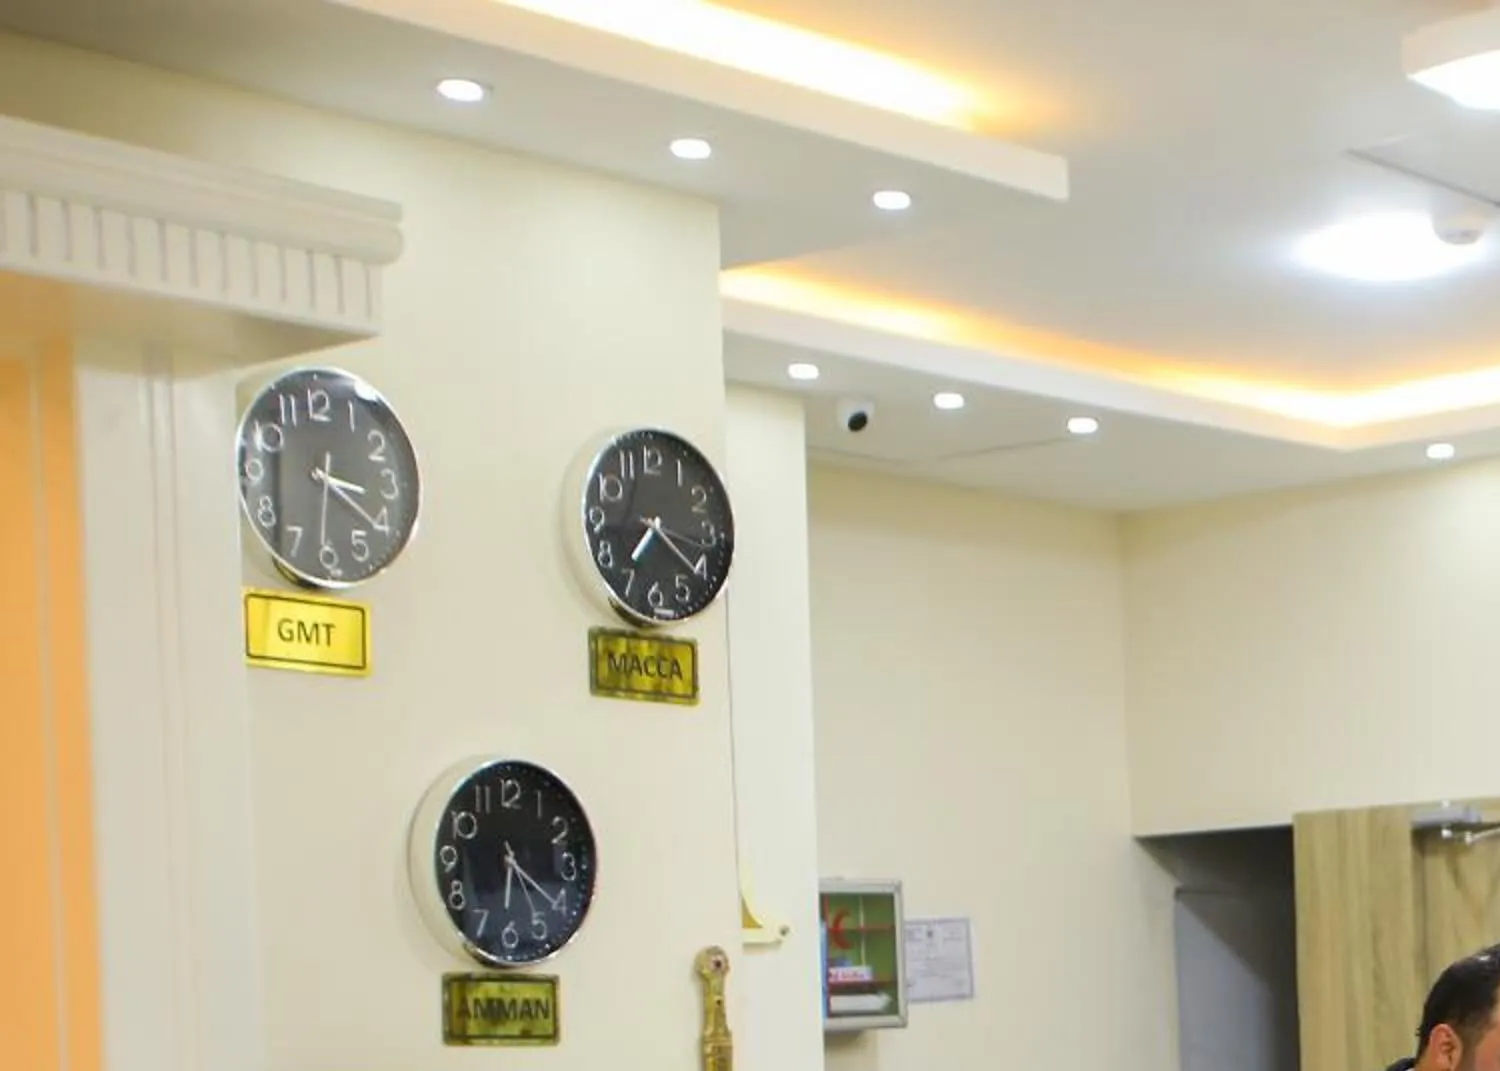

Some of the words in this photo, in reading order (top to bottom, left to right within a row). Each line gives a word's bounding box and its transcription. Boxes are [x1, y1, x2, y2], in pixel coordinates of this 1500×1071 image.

[279, 394, 297, 426] 11
[307, 388, 332, 421] 12
[367, 430, 385, 460] 2
[619, 449, 634, 480] 11
[643, 445, 663, 475] 12
[379, 469, 399, 499] 3
[598, 472, 623, 501] 10
[257, 496, 276, 527] 8
[691, 485, 707, 513] 2
[373, 507, 390, 535] 4
[589, 506, 605, 533] 9
[701, 520, 717, 548] 3
[287, 527, 303, 556] 7
[319, 540, 339, 569] 6
[351, 531, 369, 562] 5
[597, 540, 614, 568] 8
[693, 554, 708, 580] 4
[621, 568, 635, 597] 7
[647, 581, 664, 608] 6
[675, 575, 691, 602] 5
[276, 618, 336, 647] GMT
[606, 651, 684, 680] MACCA
[474, 785, 491, 814] 11
[500, 779, 522, 808] 12
[451, 810, 478, 840] 10
[551, 816, 568, 843] 2
[440, 845, 457, 872] 9
[560, 852, 577, 881] 3
[449, 880, 466, 910] 8
[551, 889, 567, 916] 4
[473, 909, 489, 937] 7
[501, 920, 518, 949] 6
[532, 911, 548, 940] 5
